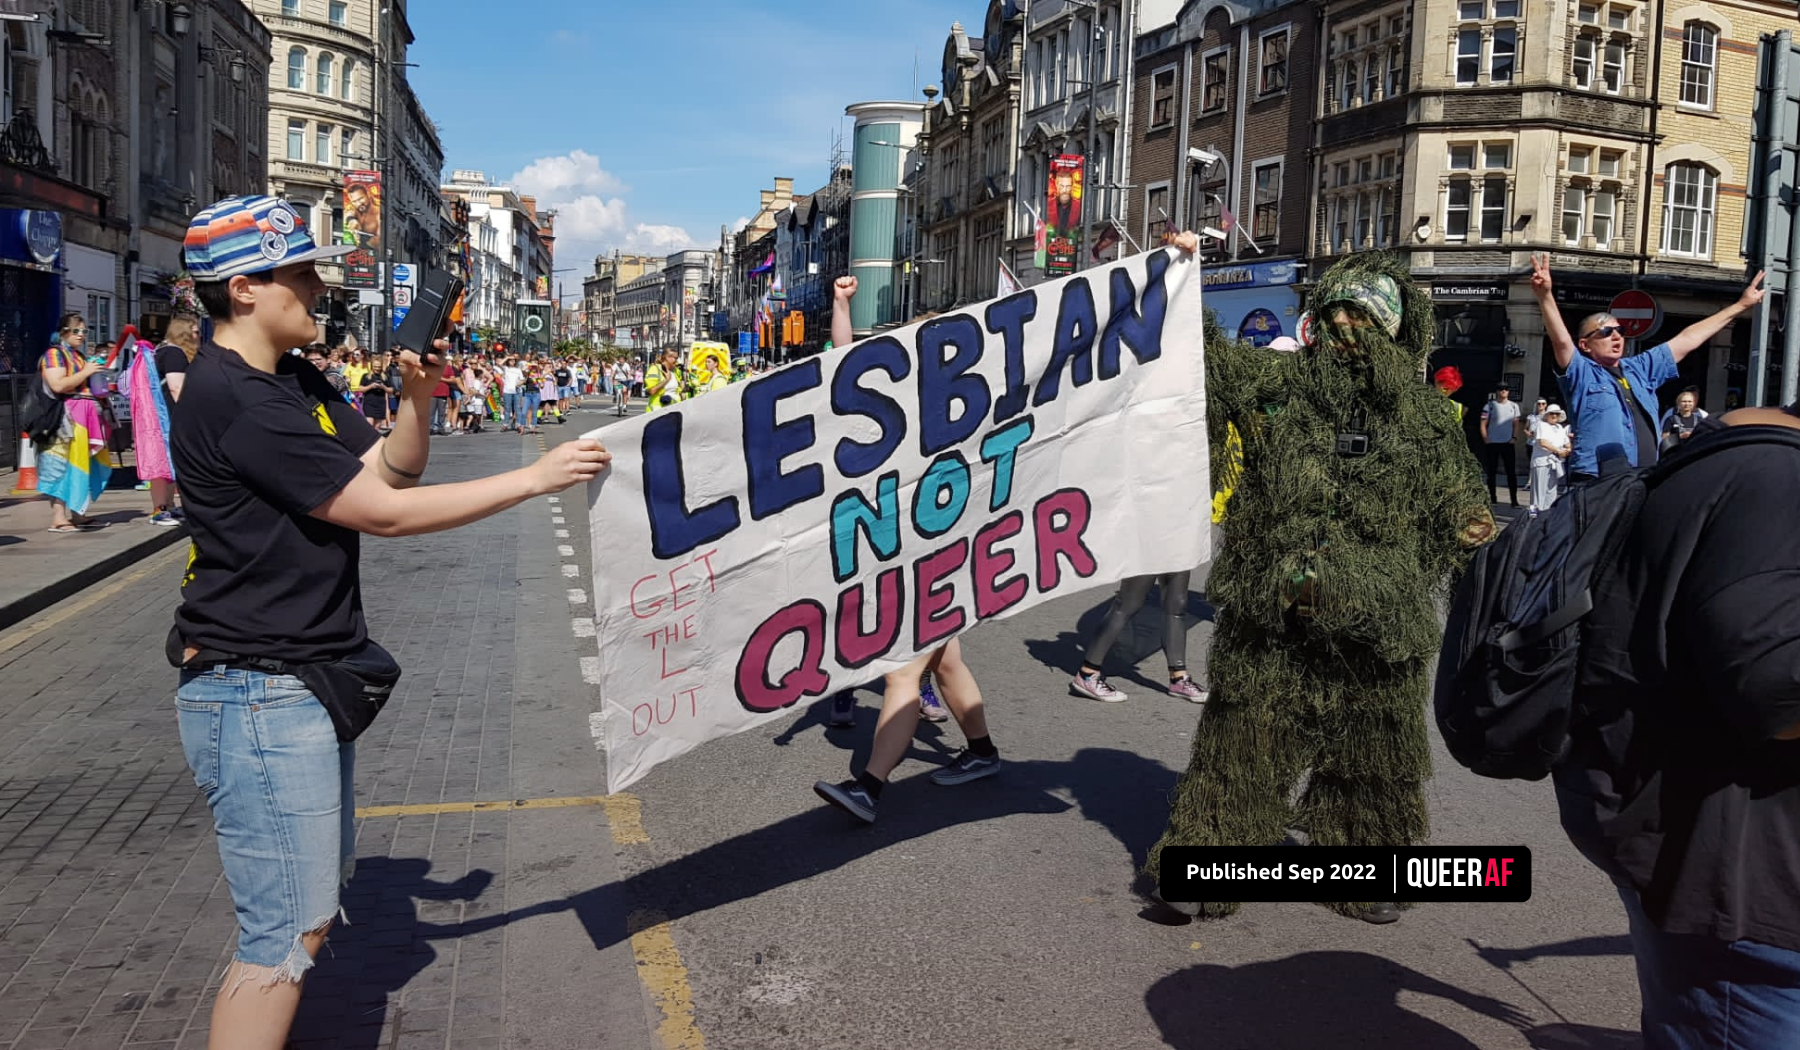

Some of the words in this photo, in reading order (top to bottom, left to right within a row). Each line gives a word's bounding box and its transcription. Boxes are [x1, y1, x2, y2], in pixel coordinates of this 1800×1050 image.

[1433, 287, 1450, 295] The
[1450, 287, 1490, 295] Cambrian
[642, 252, 1170, 559] LESBIAN
[829, 414, 1035, 584] NOT
[630, 548, 718, 619] GET
[734, 488, 1097, 713] QUEER
[642, 614, 697, 650] THE
[661, 647, 687, 680] L
[632, 684, 704, 736] OUT
